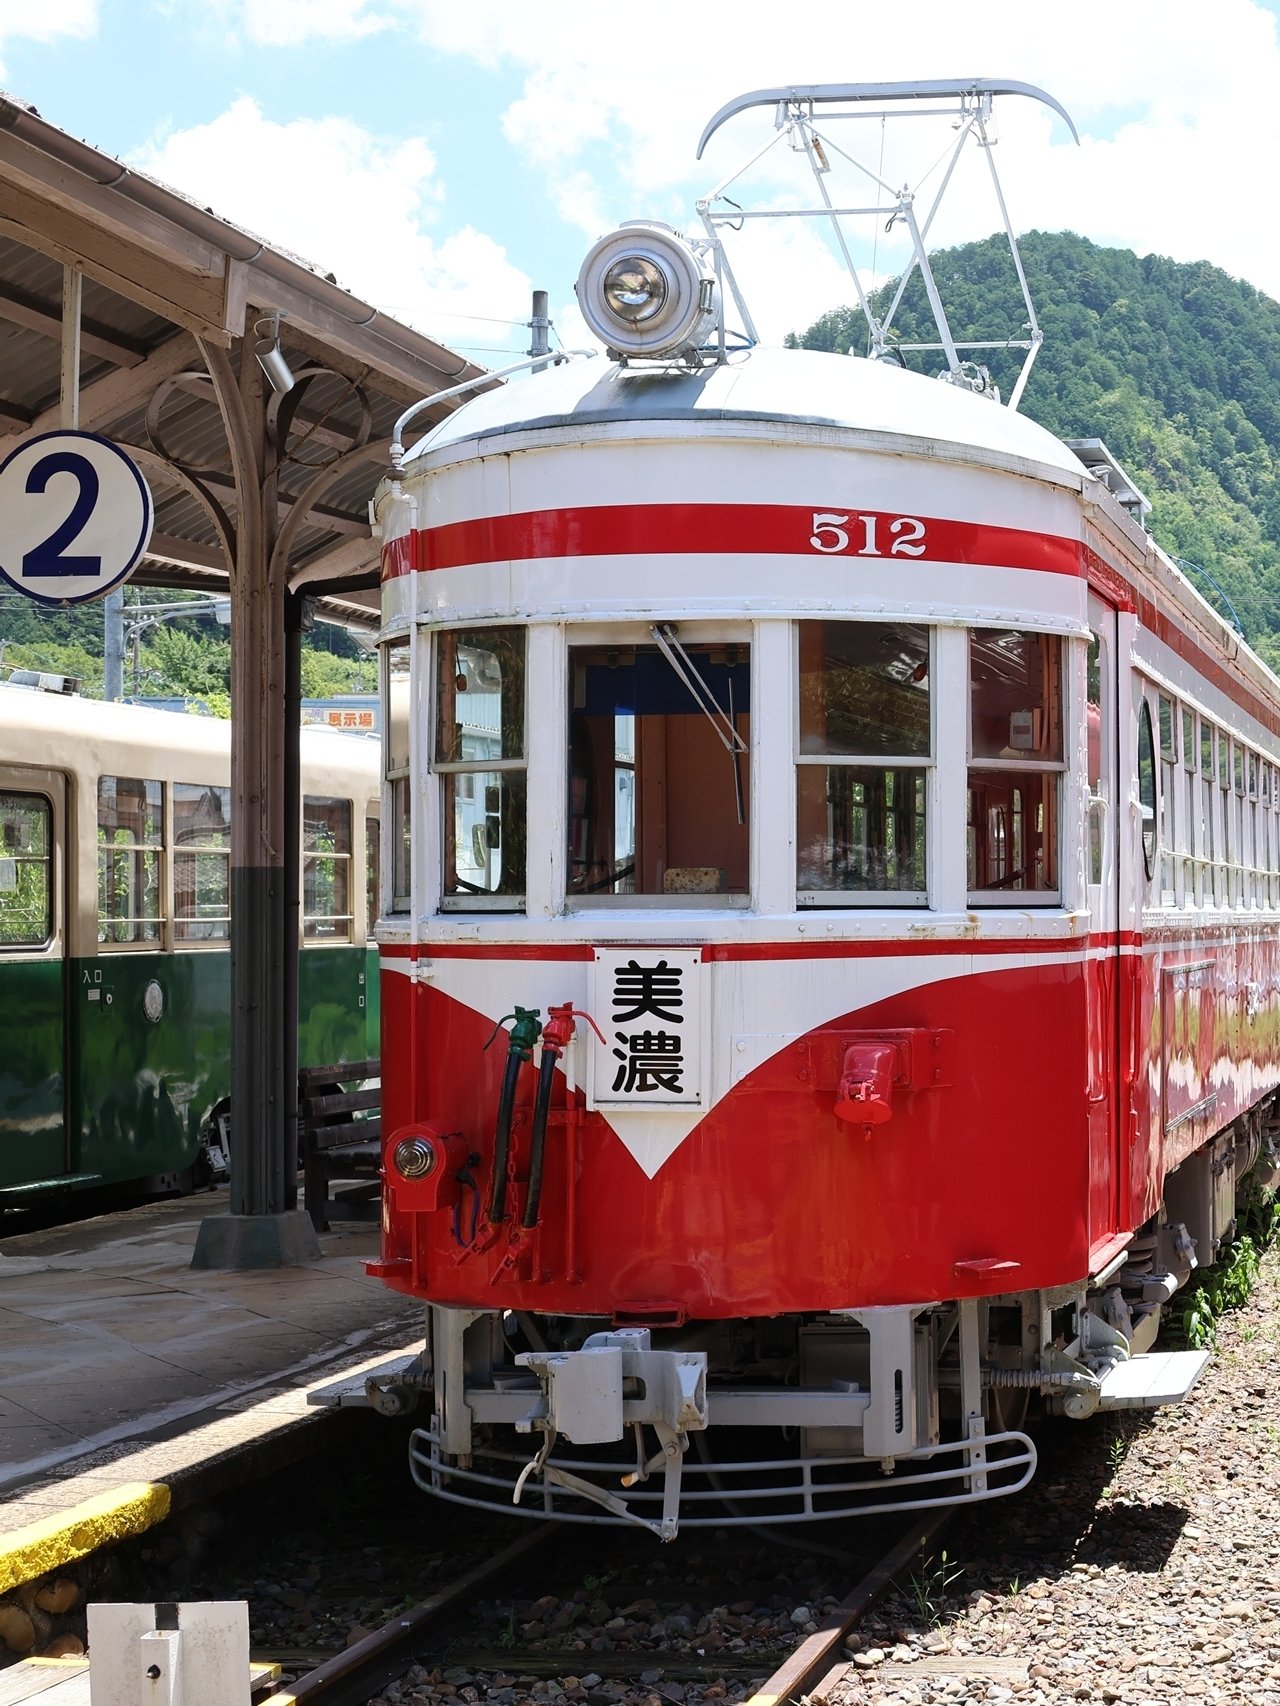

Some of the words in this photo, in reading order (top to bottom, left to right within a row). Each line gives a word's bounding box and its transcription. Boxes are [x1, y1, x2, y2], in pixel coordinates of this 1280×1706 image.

[23, 452, 101, 577] 2
[809, 511, 927, 556] 512
[83, 969, 102, 983] 入口
[612, 960, 684, 1094] 美濃
